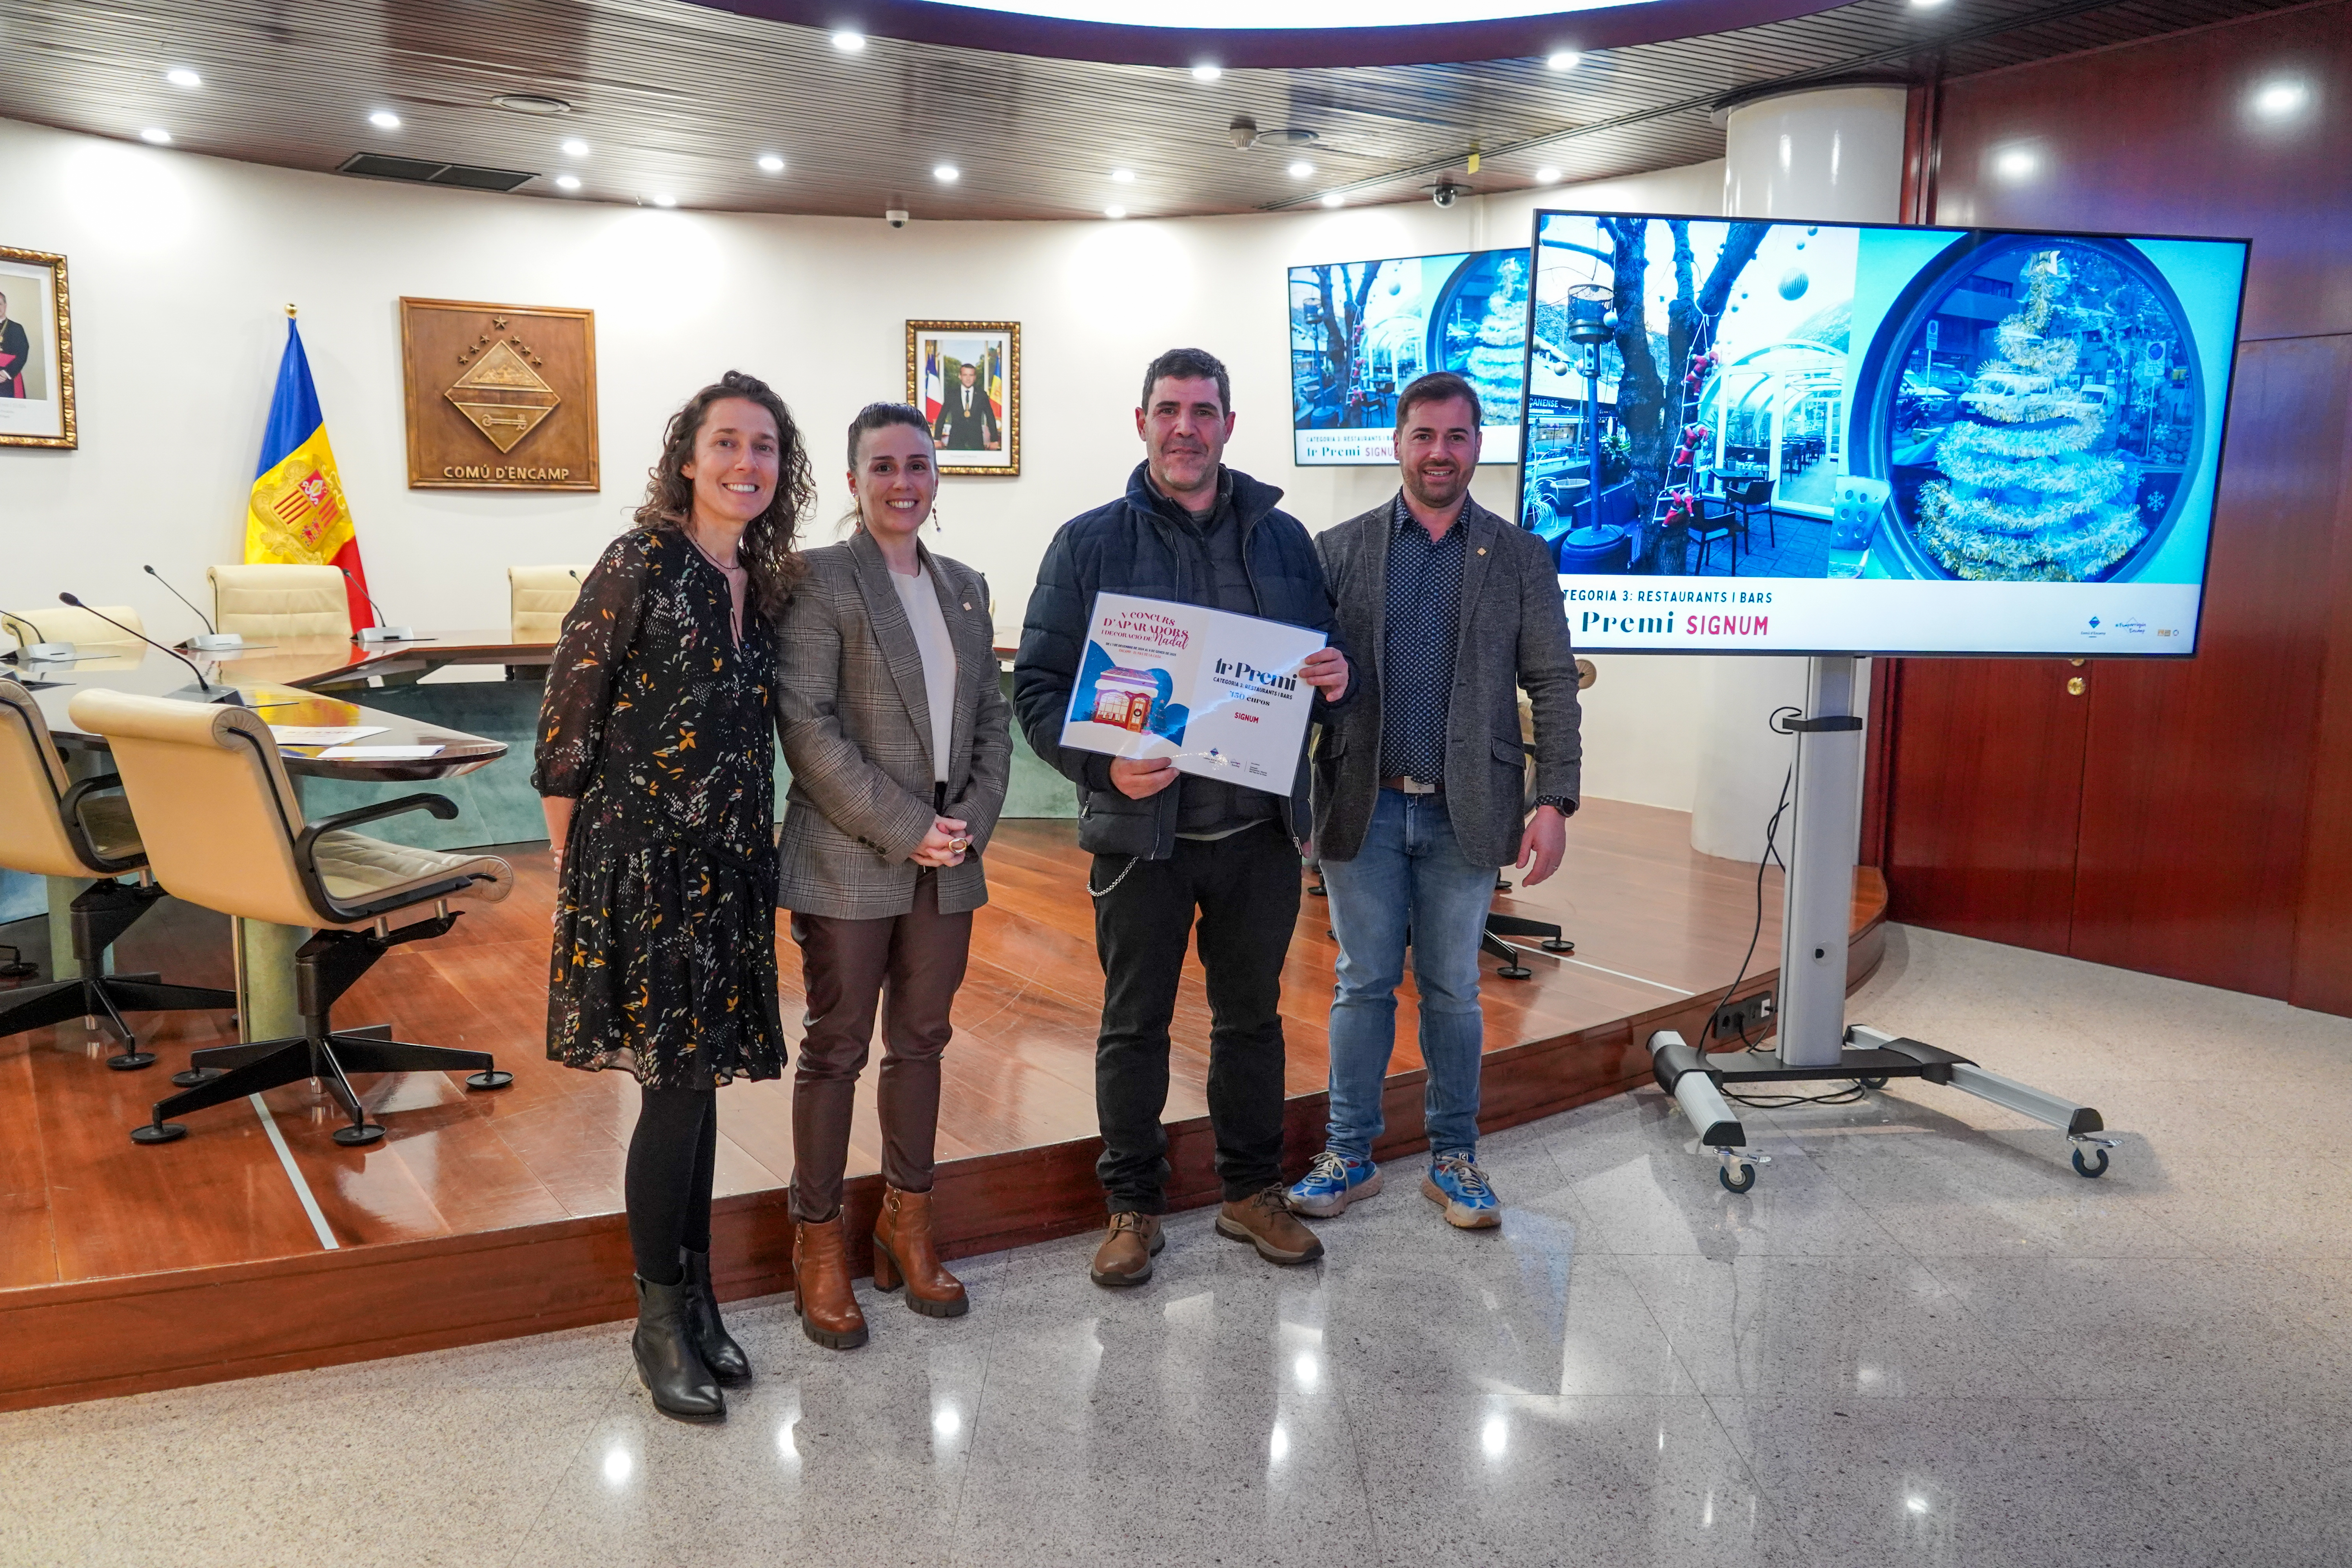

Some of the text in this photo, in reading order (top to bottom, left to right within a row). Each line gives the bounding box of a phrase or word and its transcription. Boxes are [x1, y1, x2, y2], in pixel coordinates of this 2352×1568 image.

[1322, 446, 1360, 456] Premi
[1365, 447, 1393, 456] SIGNU
[443, 464, 569, 480] COMÚ D'ENCAMP
[1563, 590, 1617, 601] TEGORIA
[1622, 590, 1633, 601] 3:
[1638, 591, 1727, 603] RESTAURANTS
[1740, 592, 1772, 603] BARS
[1130, 612, 1175, 626] CONCURS
[1582, 611, 1768, 635] Premi SIGNUM
[1103, 618, 1189, 639] D'APARADORS
[1105, 630, 1142, 640] DECORACIÓ
[1153, 632, 1189, 650] Nadal
[1215, 658, 1298, 691] 1r Premi
[1213, 677, 1239, 687] CATEGORIA
[1245, 684, 1277, 696] RESTAURANTS
[1230, 691, 1270, 706] 150 euros
[1234, 712, 1259, 724] SIGNUM
